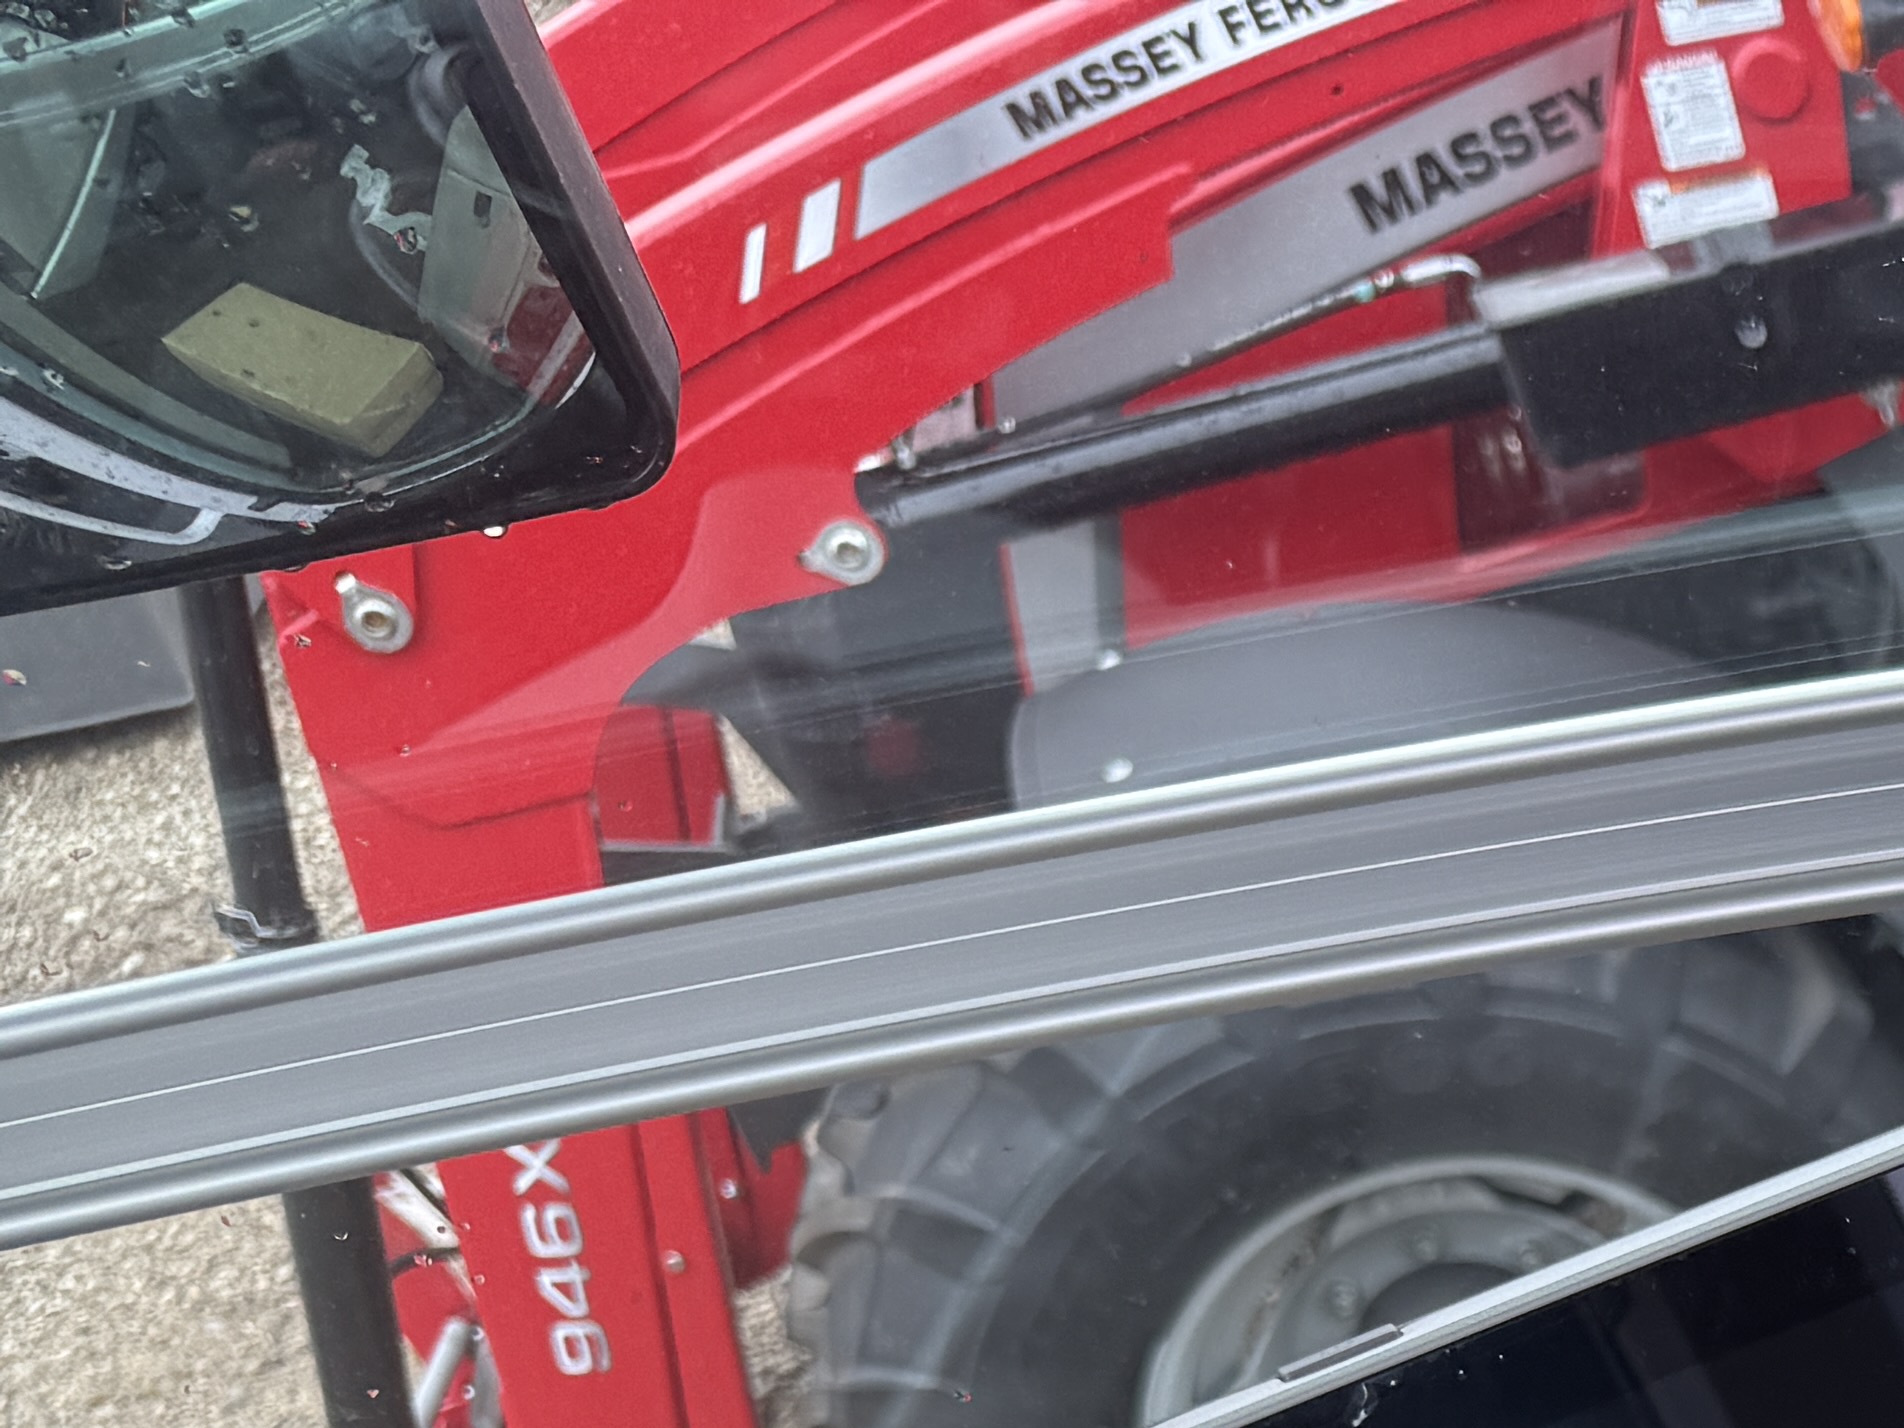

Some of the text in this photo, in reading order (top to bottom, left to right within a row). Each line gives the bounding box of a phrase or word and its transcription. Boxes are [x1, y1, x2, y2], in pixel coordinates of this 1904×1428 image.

[1004, 21, 1205, 140] MASSEY
[1348, 72, 1605, 235] MASSEY
[505, 1138, 612, 1376] 946X
